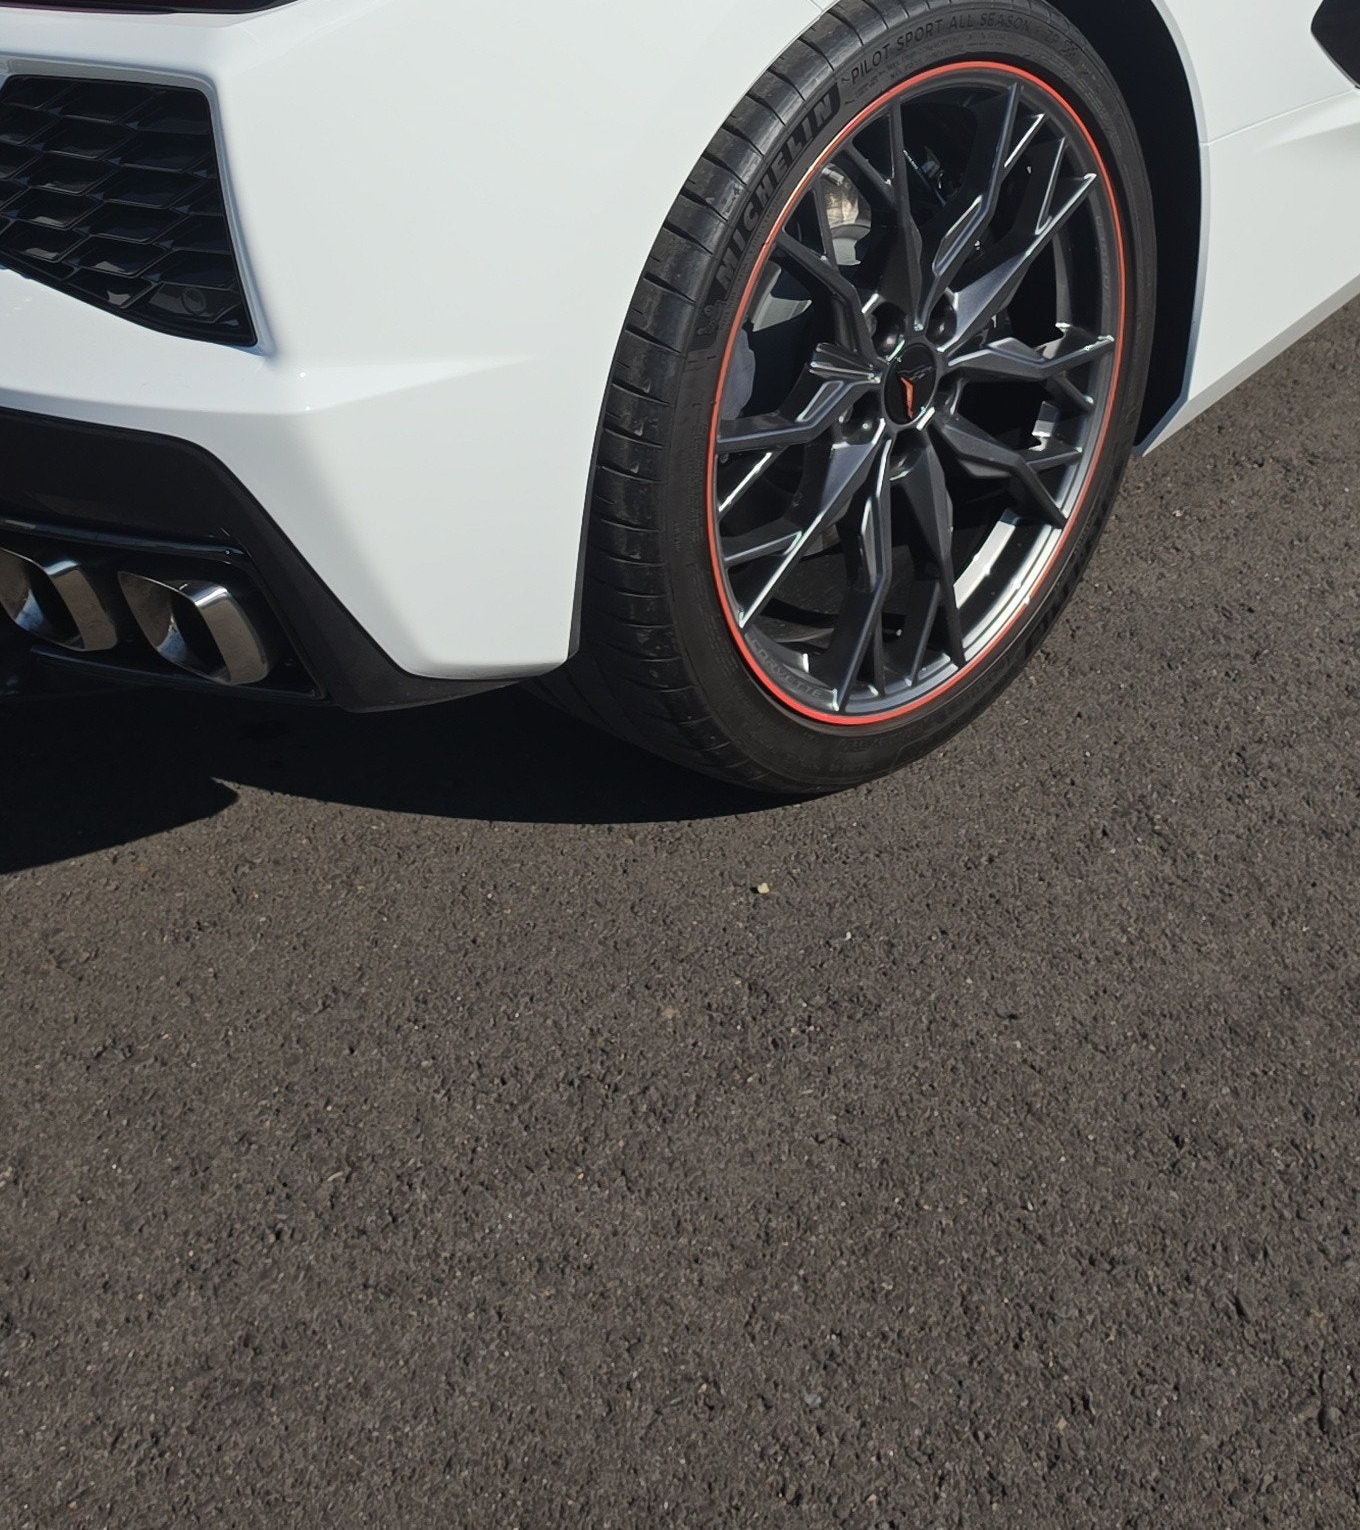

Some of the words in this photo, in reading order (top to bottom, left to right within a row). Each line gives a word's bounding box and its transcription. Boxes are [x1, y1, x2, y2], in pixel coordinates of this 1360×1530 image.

[851, 46, 891, 85] PILOT
[897, 19, 944, 51] SPORT
[948, 15, 974, 30] ALL
[980, 12, 1033, 32] SEASON
[715, 90, 836, 287] MICHELIN
